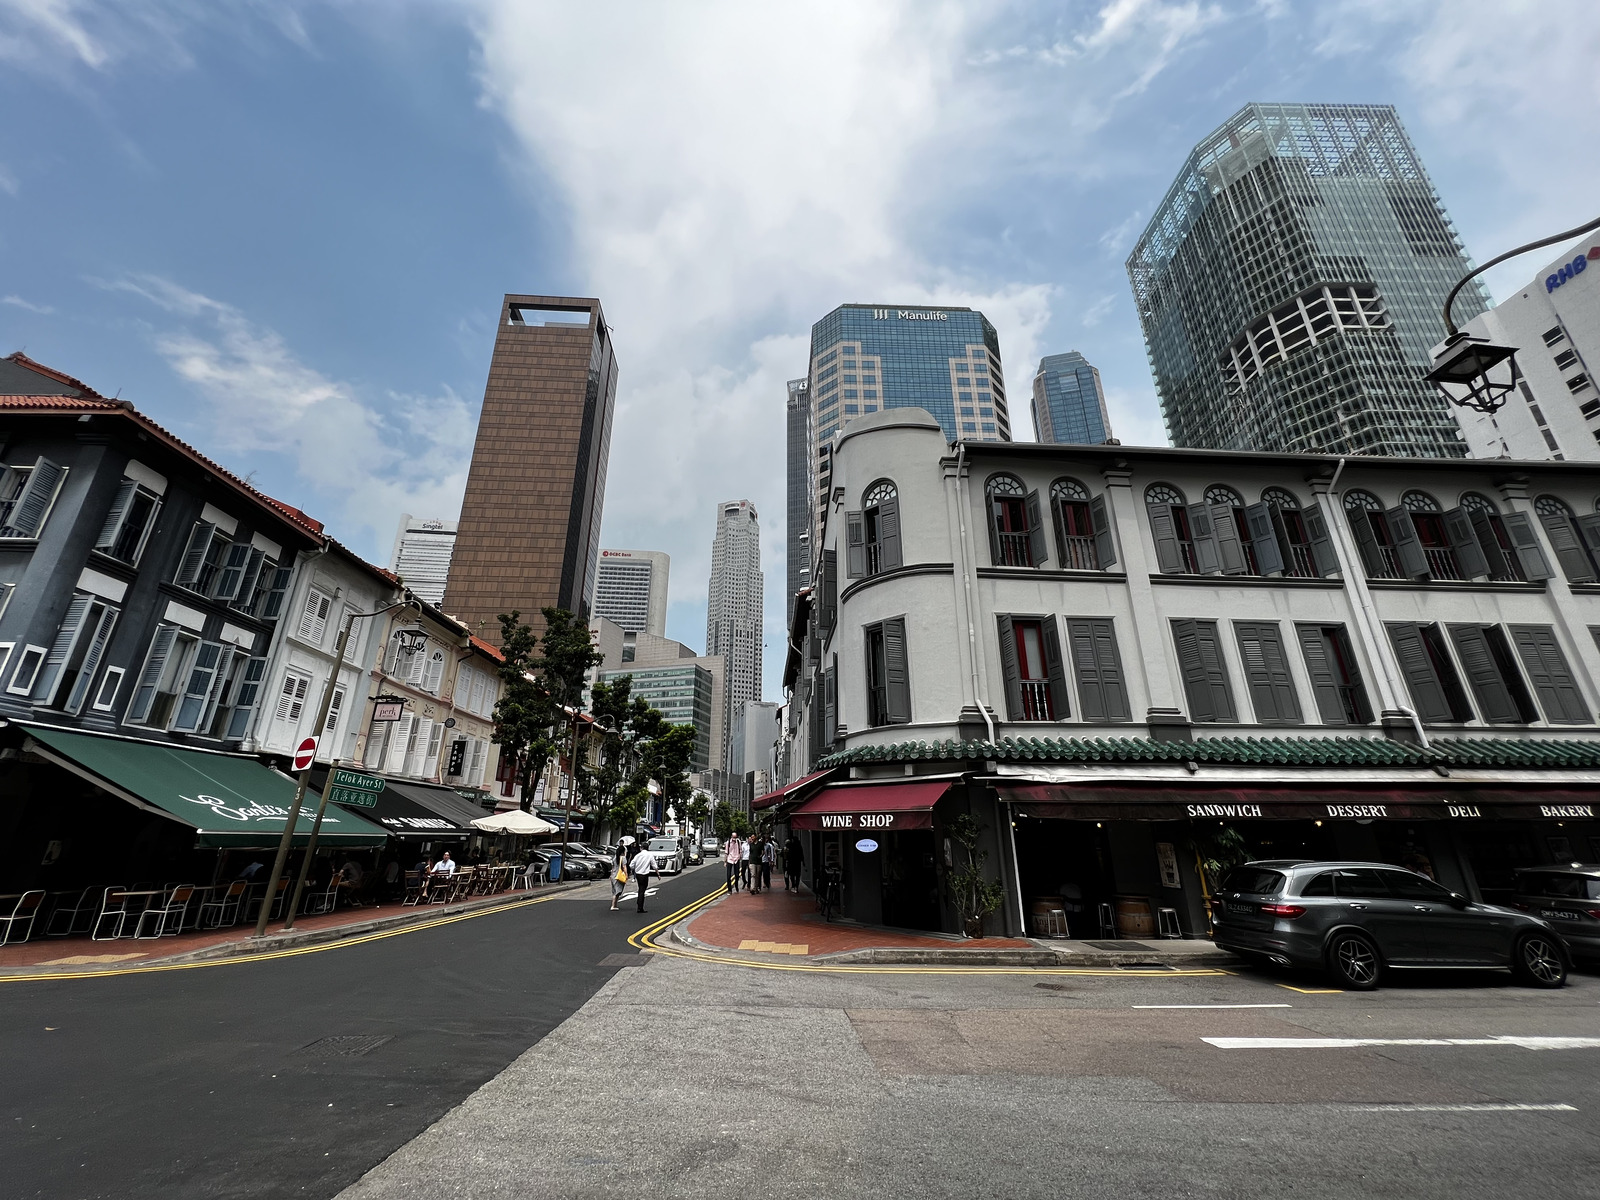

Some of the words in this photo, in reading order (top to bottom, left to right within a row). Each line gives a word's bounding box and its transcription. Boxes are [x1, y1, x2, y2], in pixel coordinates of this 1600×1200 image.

[1545, 254, 1587, 294] RHB
[898, 310, 948, 320] Manulife
[336, 771, 356, 784] Telok
[355, 775, 373, 787] Ayer
[374, 780, 382, 789] St
[1187, 804, 1263, 817] SANDWICH
[1326, 804, 1388, 817] DESSERT
[1448, 805, 1481, 817] DELI
[1539, 805, 1594, 817] BAKERY
[821, 815, 853, 828] WINE
[860, 814, 894, 827] SHOP
